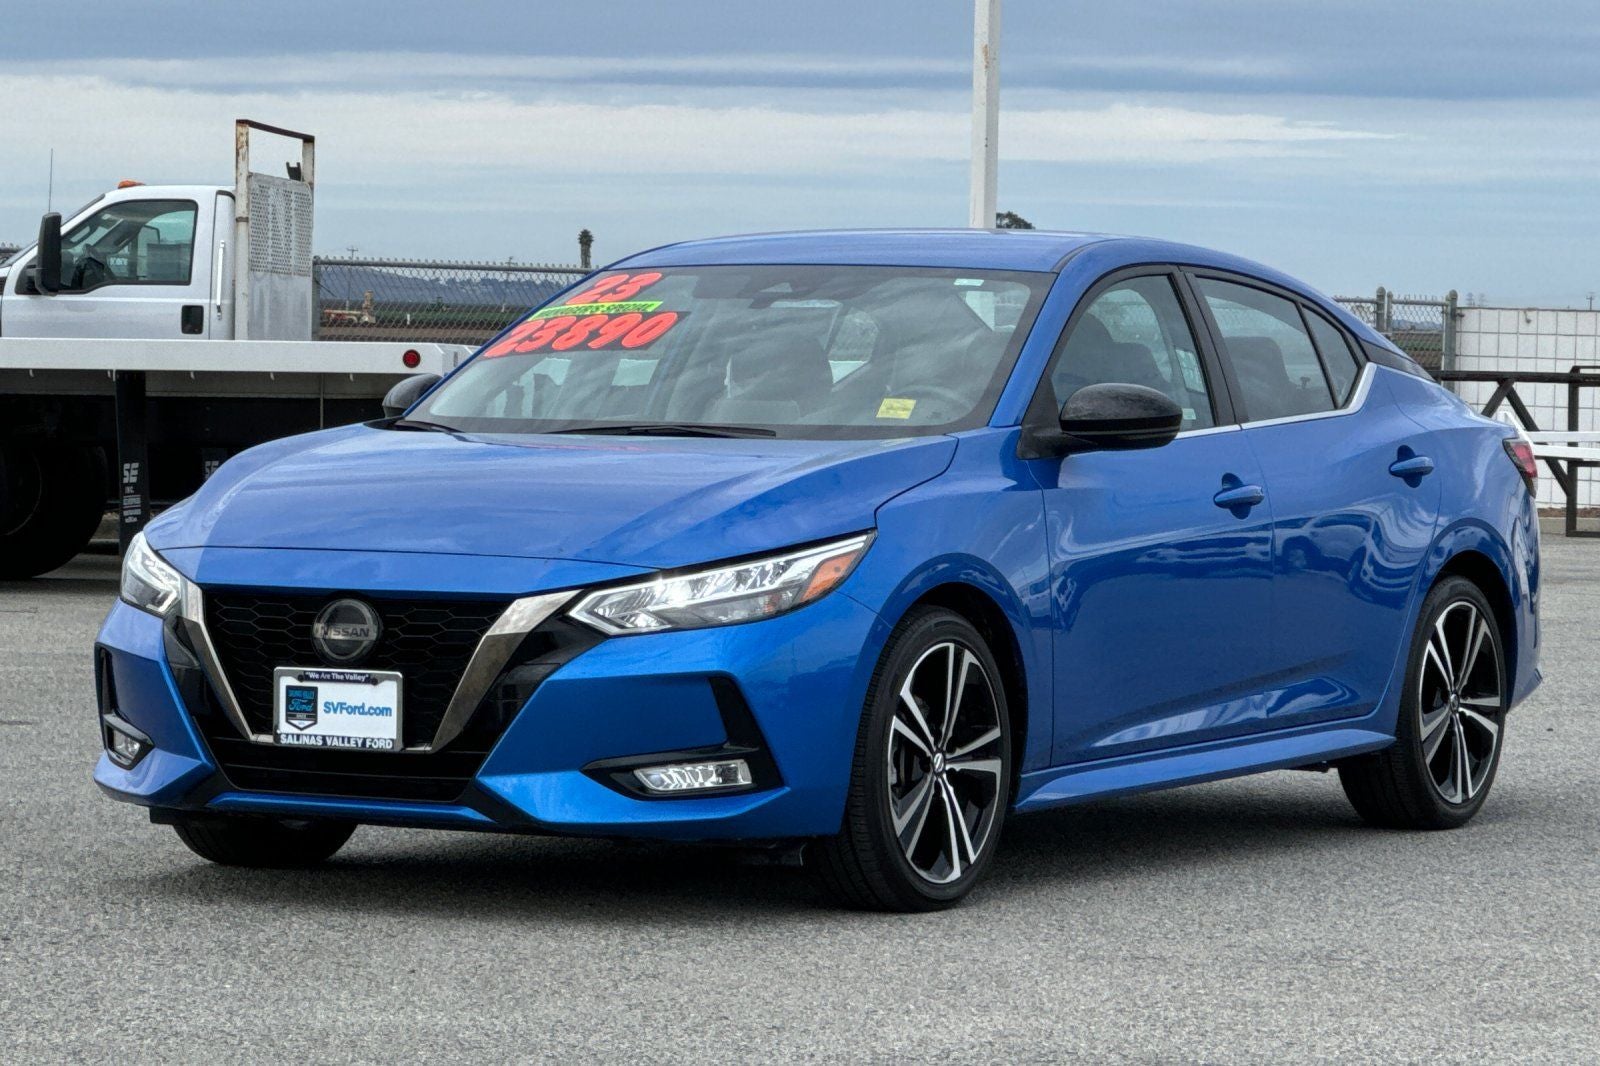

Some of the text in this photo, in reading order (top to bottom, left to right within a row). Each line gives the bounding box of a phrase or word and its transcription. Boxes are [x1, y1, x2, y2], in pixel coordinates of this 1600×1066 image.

[566, 272, 662, 305] 23
[484, 312, 678, 358] 23890
[123, 462, 139, 483] SE
[321, 627, 370, 638] NISSAN
[289, 699, 314, 712] Ford
[323, 702, 392, 716] SVFord.com
[280, 734, 393, 749] SALINAS VALLEY FORD
